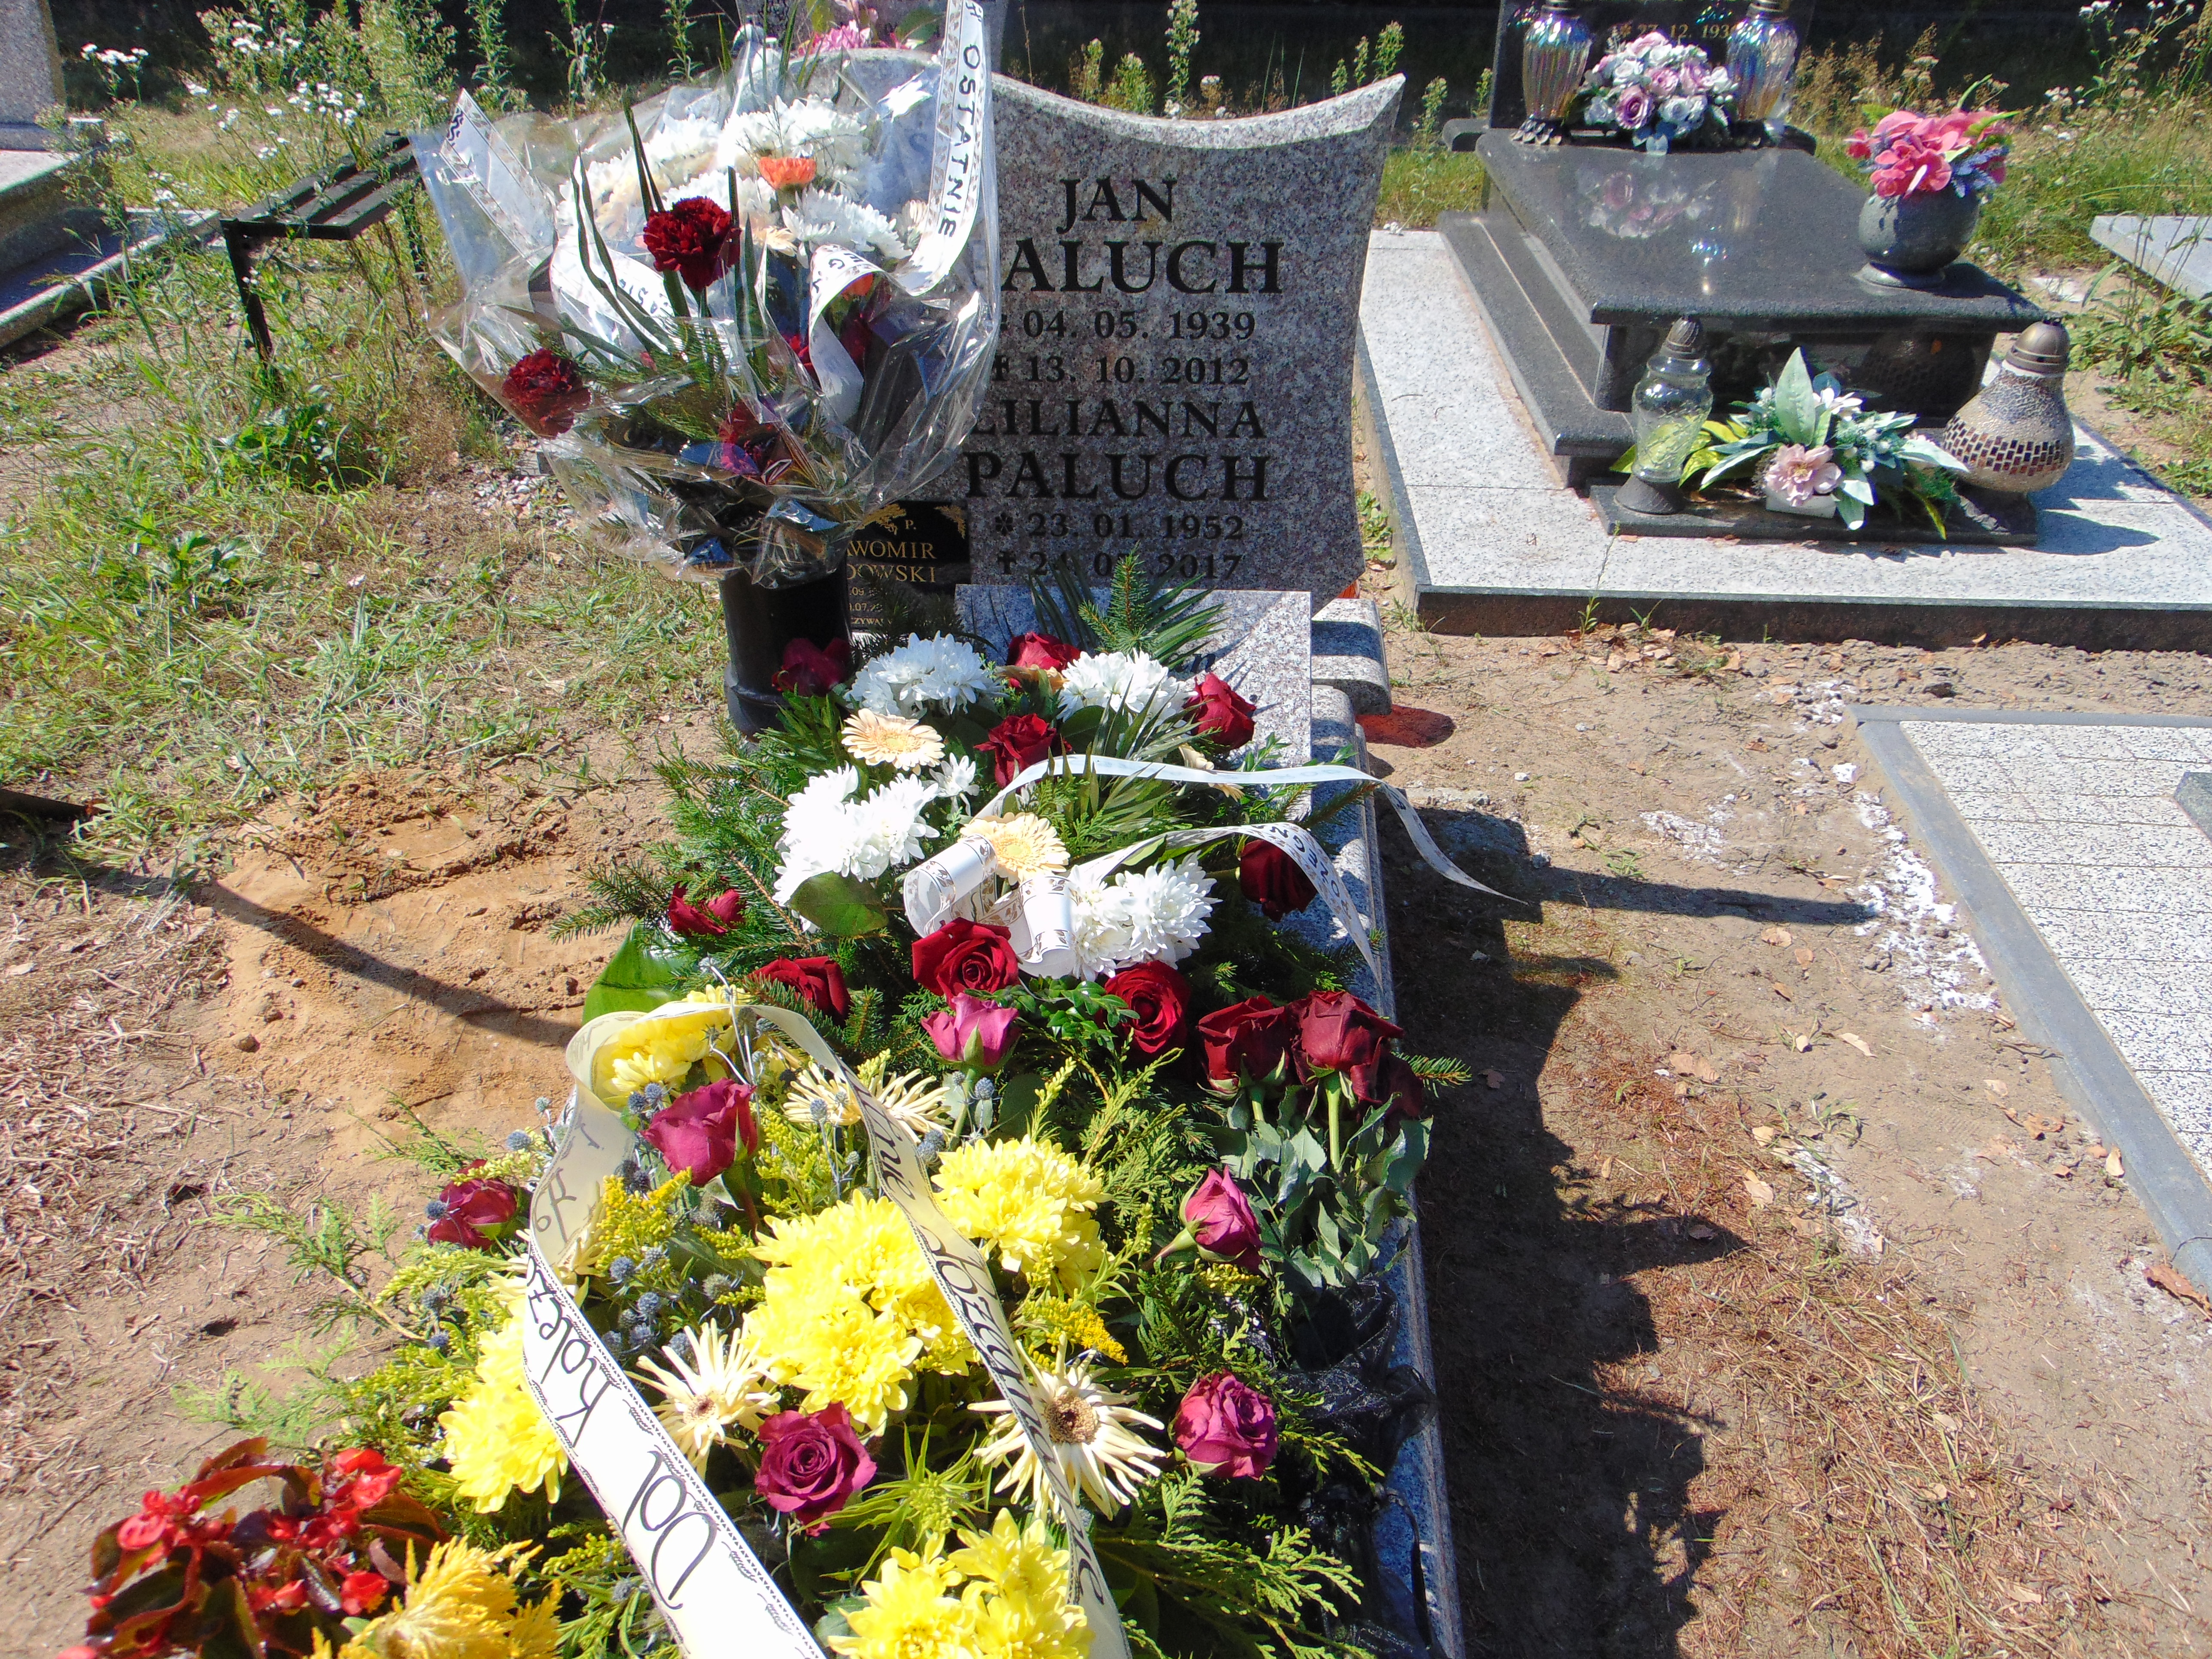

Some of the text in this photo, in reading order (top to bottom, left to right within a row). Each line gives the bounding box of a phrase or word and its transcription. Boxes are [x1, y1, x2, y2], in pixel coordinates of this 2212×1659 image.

[1702, 24, 1737, 39] 193
[938, 44, 980, 238] OSTATNIE
[1057, 177, 1179, 234] JAN
[1003, 239, 1285, 294] ALUCH
[1023, 310, 1256, 341] 04. 05. 1939
[1030, 357, 1249, 386] 13. 10. 2012
[963, 451, 1272, 501] PALUCH
[905, 520, 917, 530] P.
[1030, 514, 1243, 541] 23. 01. 1952
[1159, 553, 1245, 580] 2017
